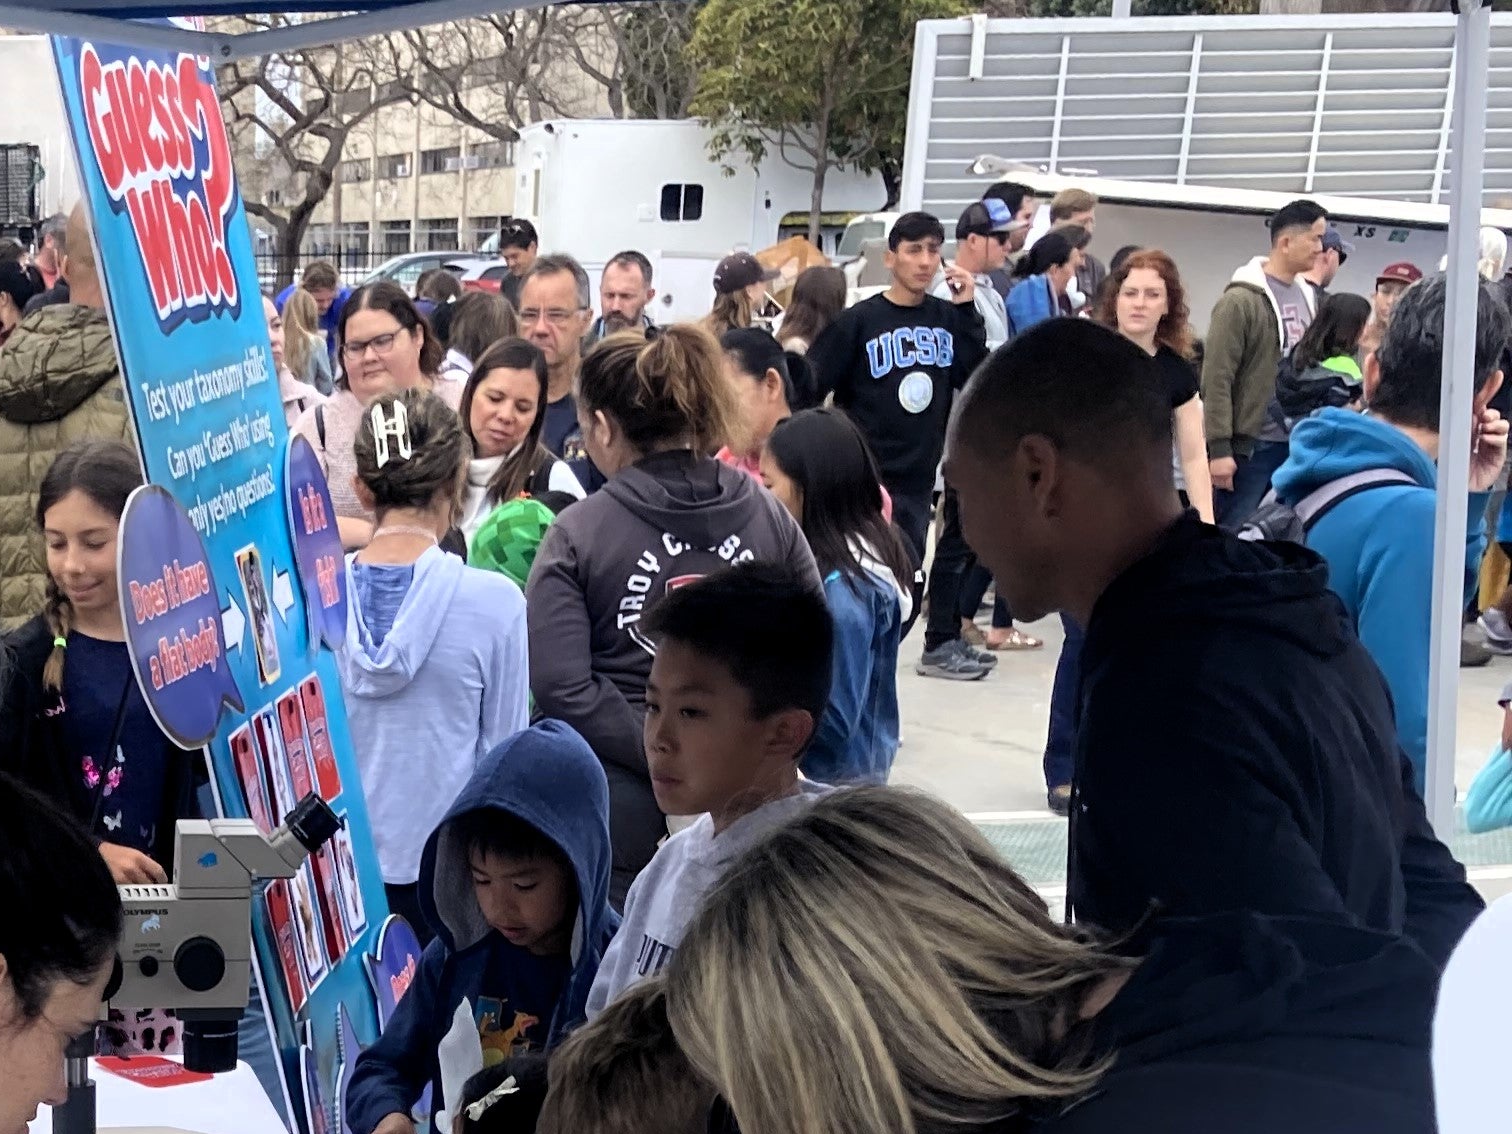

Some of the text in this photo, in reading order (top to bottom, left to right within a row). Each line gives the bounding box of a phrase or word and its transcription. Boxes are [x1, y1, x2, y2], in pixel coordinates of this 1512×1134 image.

[141, 345, 269, 426] Test your taxonomy skills!
[865, 326, 954, 379] UCSB
[167, 446, 188, 480] Can
[186, 443, 207, 482] you
[250, 409, 275, 448] using
[235, 463, 276, 519] questions?
[129, 559, 210, 625] Does it have
[617, 550, 661, 630] TROY
[149, 616, 220, 691] a flat body?
[123, 908, 169, 916] OLYMPUS
